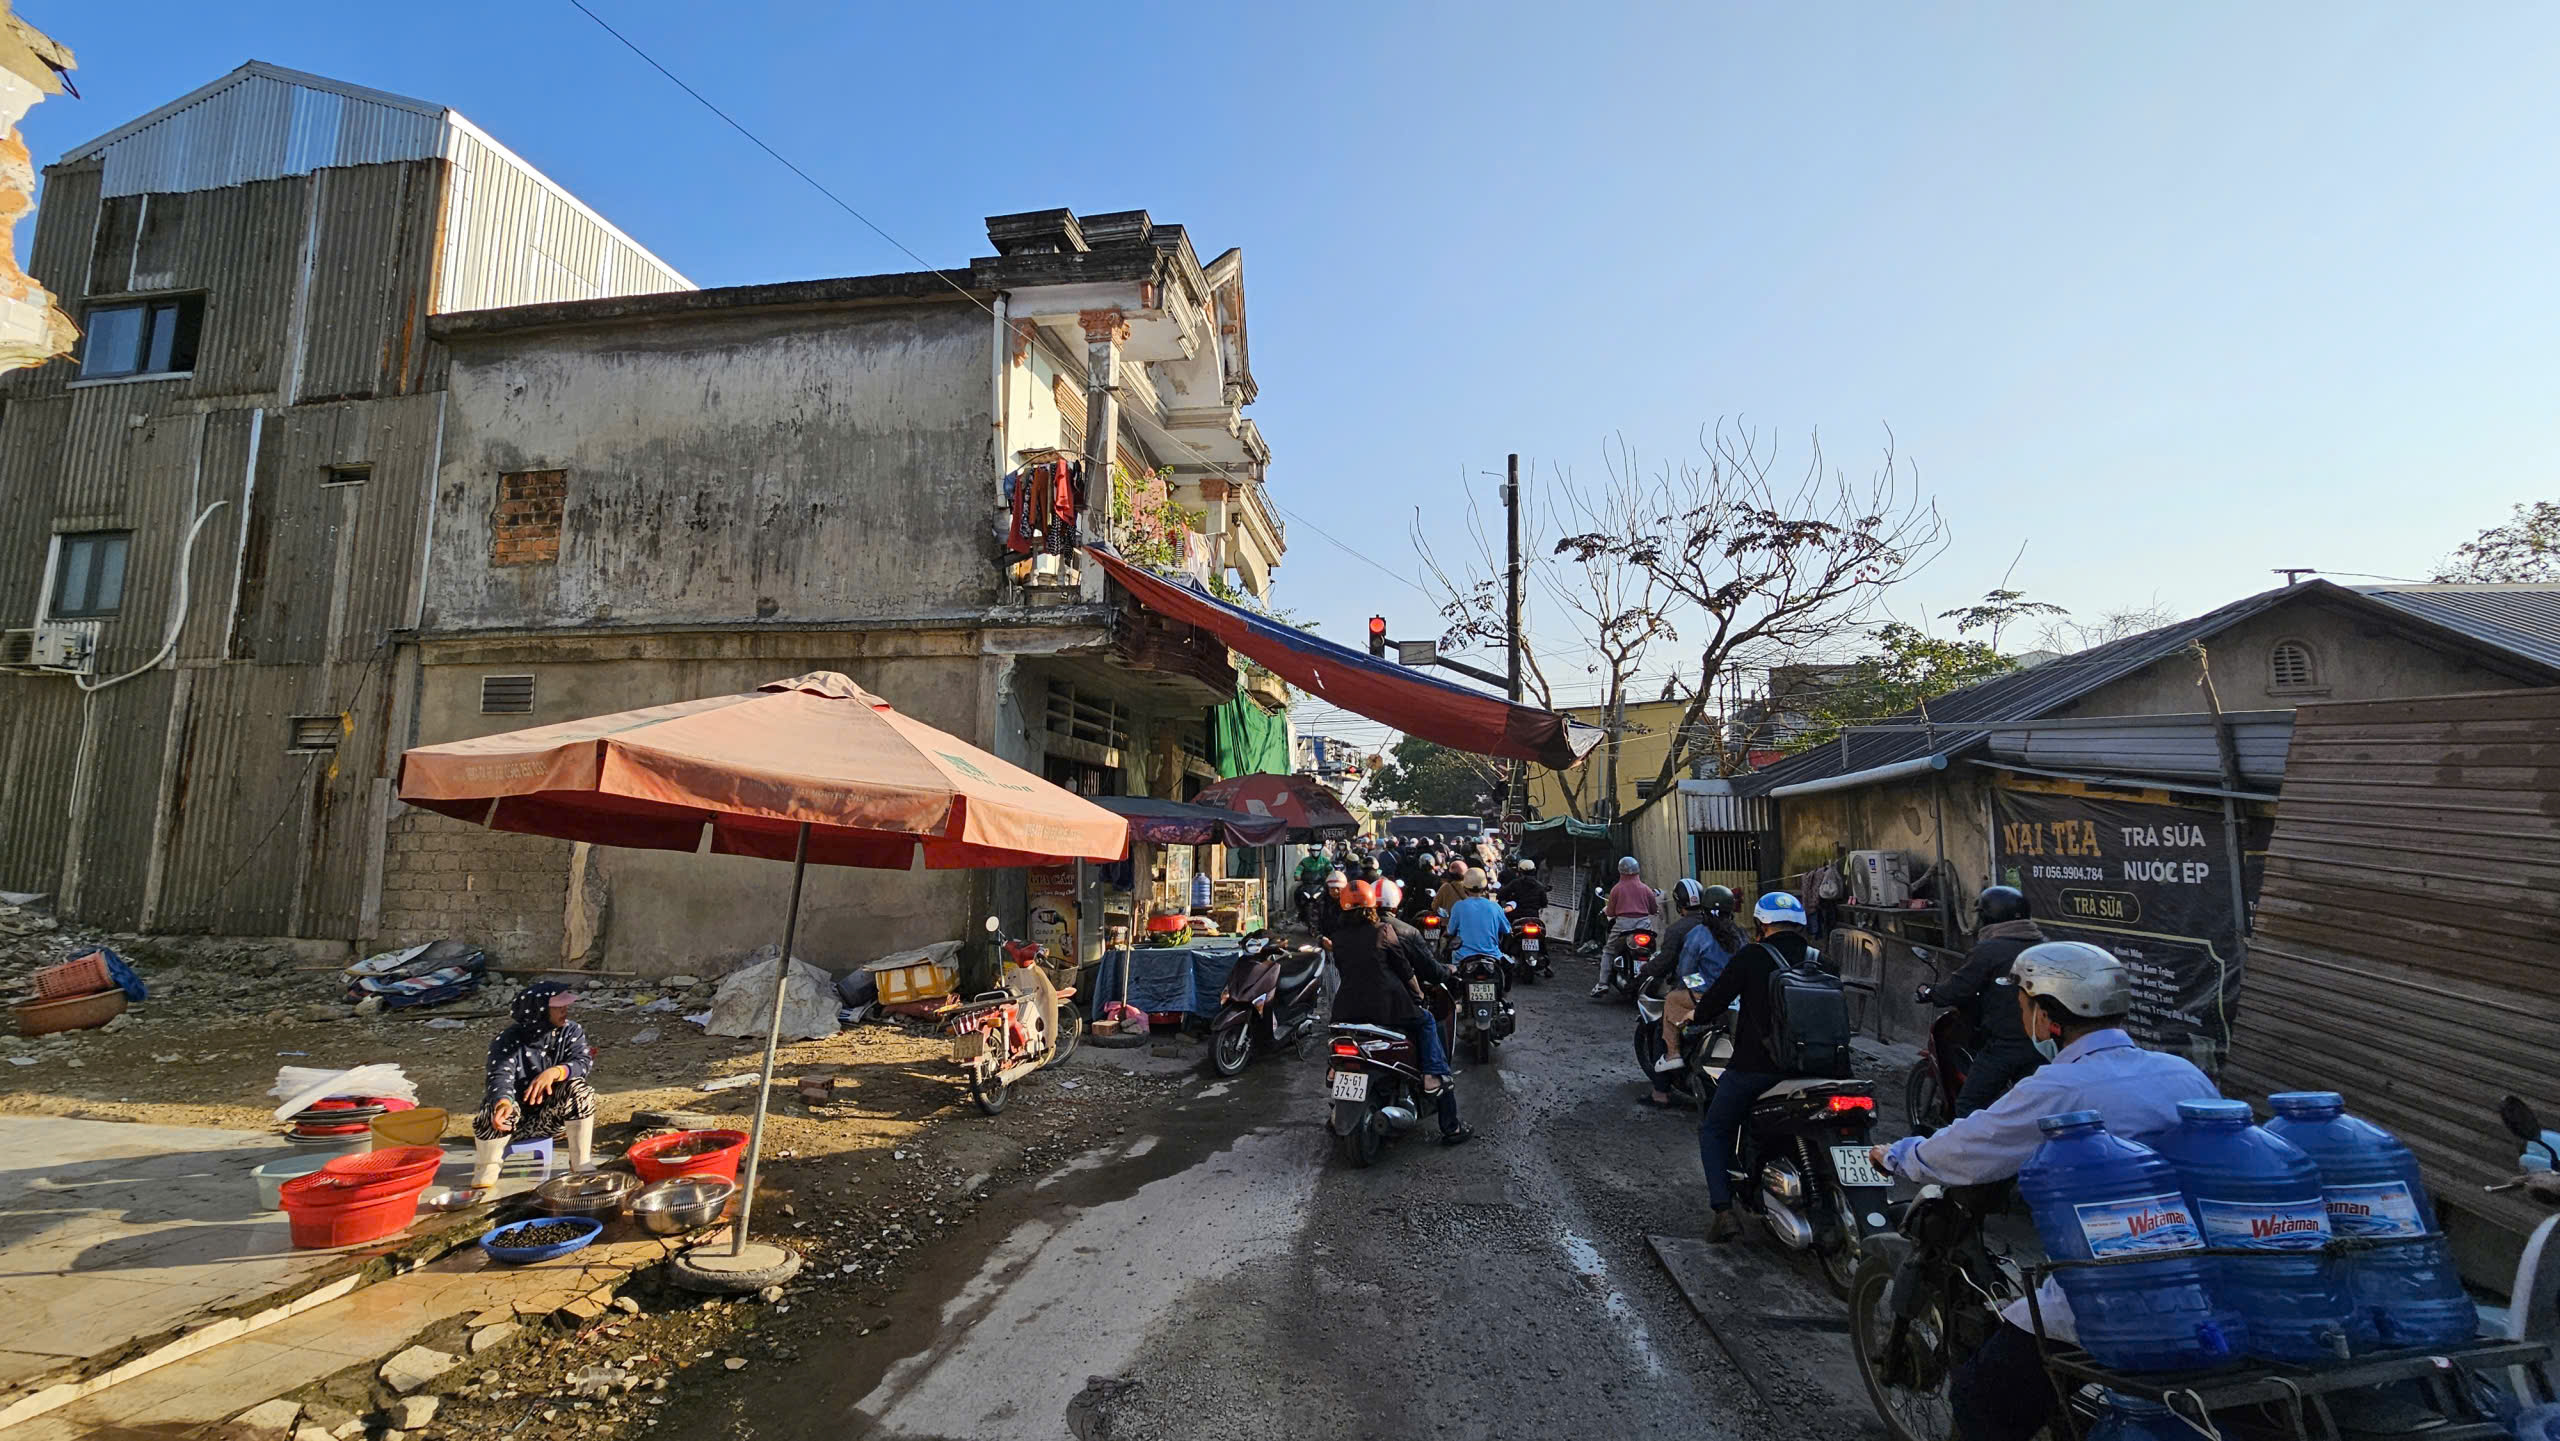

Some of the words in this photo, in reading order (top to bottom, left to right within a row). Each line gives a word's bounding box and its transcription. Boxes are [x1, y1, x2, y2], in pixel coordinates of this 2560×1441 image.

[2003, 822, 2044, 856] NAI
[2051, 819, 2102, 857] TEA
[2121, 824, 2160, 847] TRÀ
[2162, 822, 2207, 847] SỮA
[2033, 865, 2044, 878] ĐT
[2046, 865, 2103, 881] 056.9904.784
[2123, 858, 2179, 883] NƯỚC
[2182, 859, 2209, 884] ÉP
[2073, 893, 2097, 915] TRÀ
[2100, 895, 2124, 918] SỮA
[1840, 1150, 1869, 1165] 75-F
[2326, 1202, 2370, 1216] aman
[2127, 1208, 2187, 1237] Wataman
[2251, 1214, 2319, 1238] Wataman
